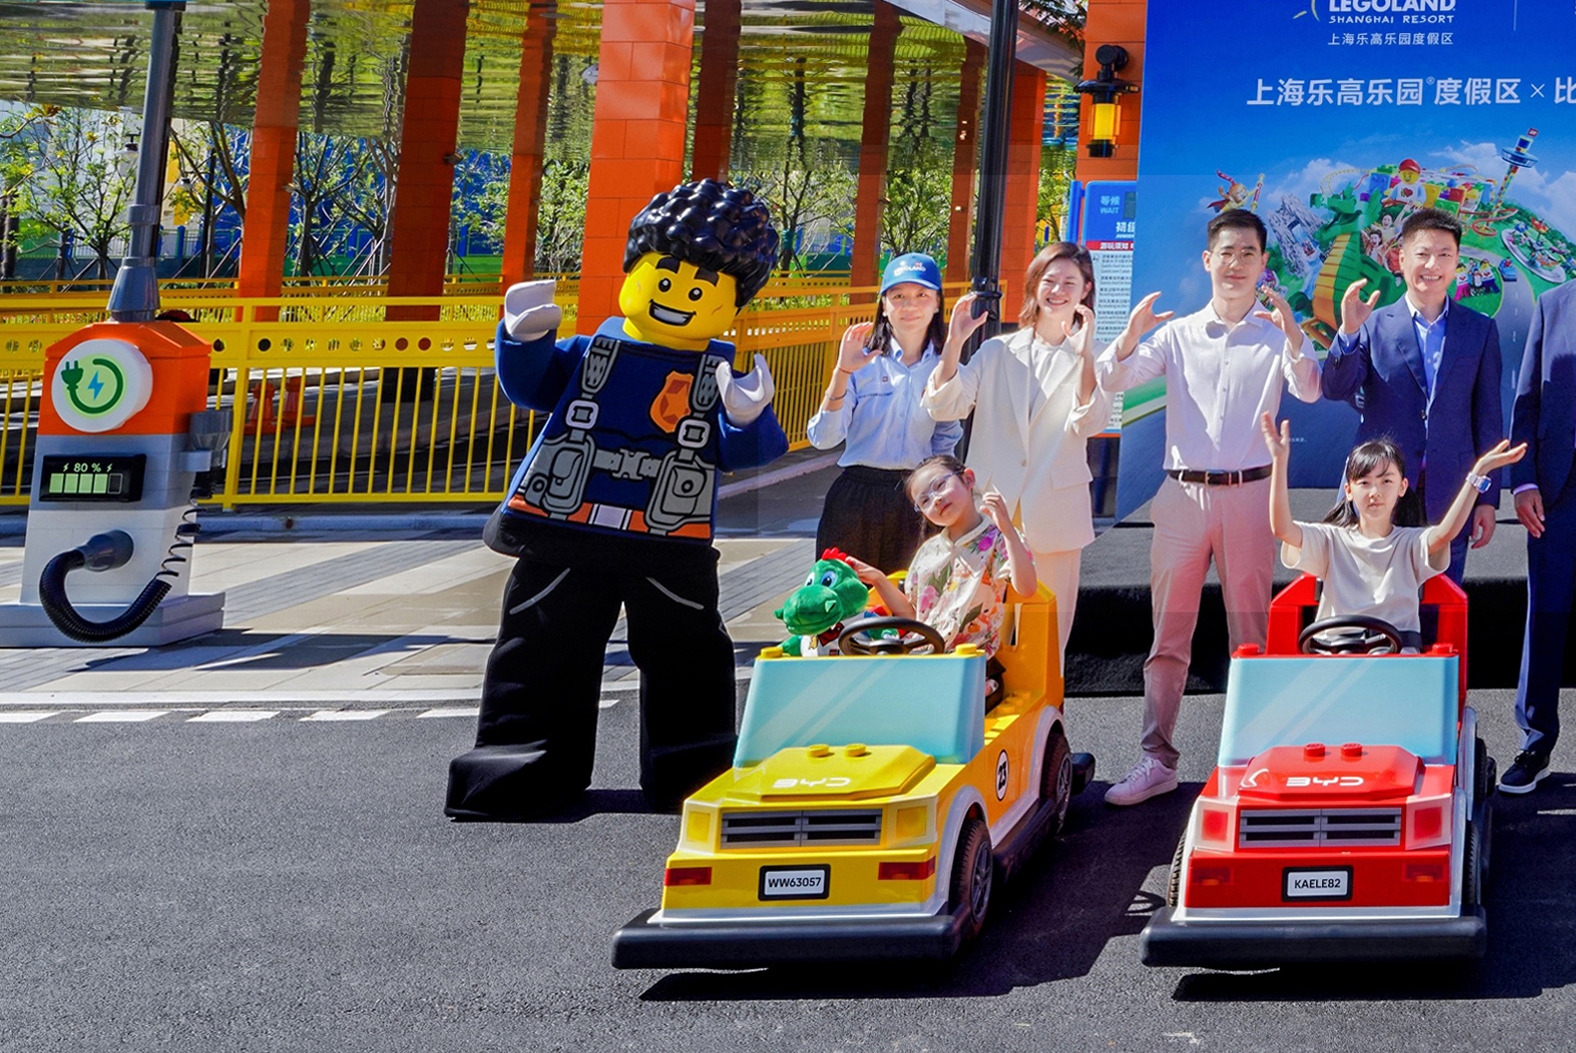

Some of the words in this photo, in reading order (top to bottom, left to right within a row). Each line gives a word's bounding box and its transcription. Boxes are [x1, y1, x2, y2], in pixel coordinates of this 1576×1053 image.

[1328, 15, 1394, 24] SHANGHAI
[1402, 14, 1454, 24] RESORT
[1328, 32, 1454, 46] 上海乐高乐园度假区
[73, 462, 88, 472] 80
[91, 463, 102, 472] %
[772, 777, 850, 788] BYD
[1286, 776, 1364, 787] BYD
[768, 876, 822, 889] WW63057
[1294, 878, 1341, 890] KAELE82
